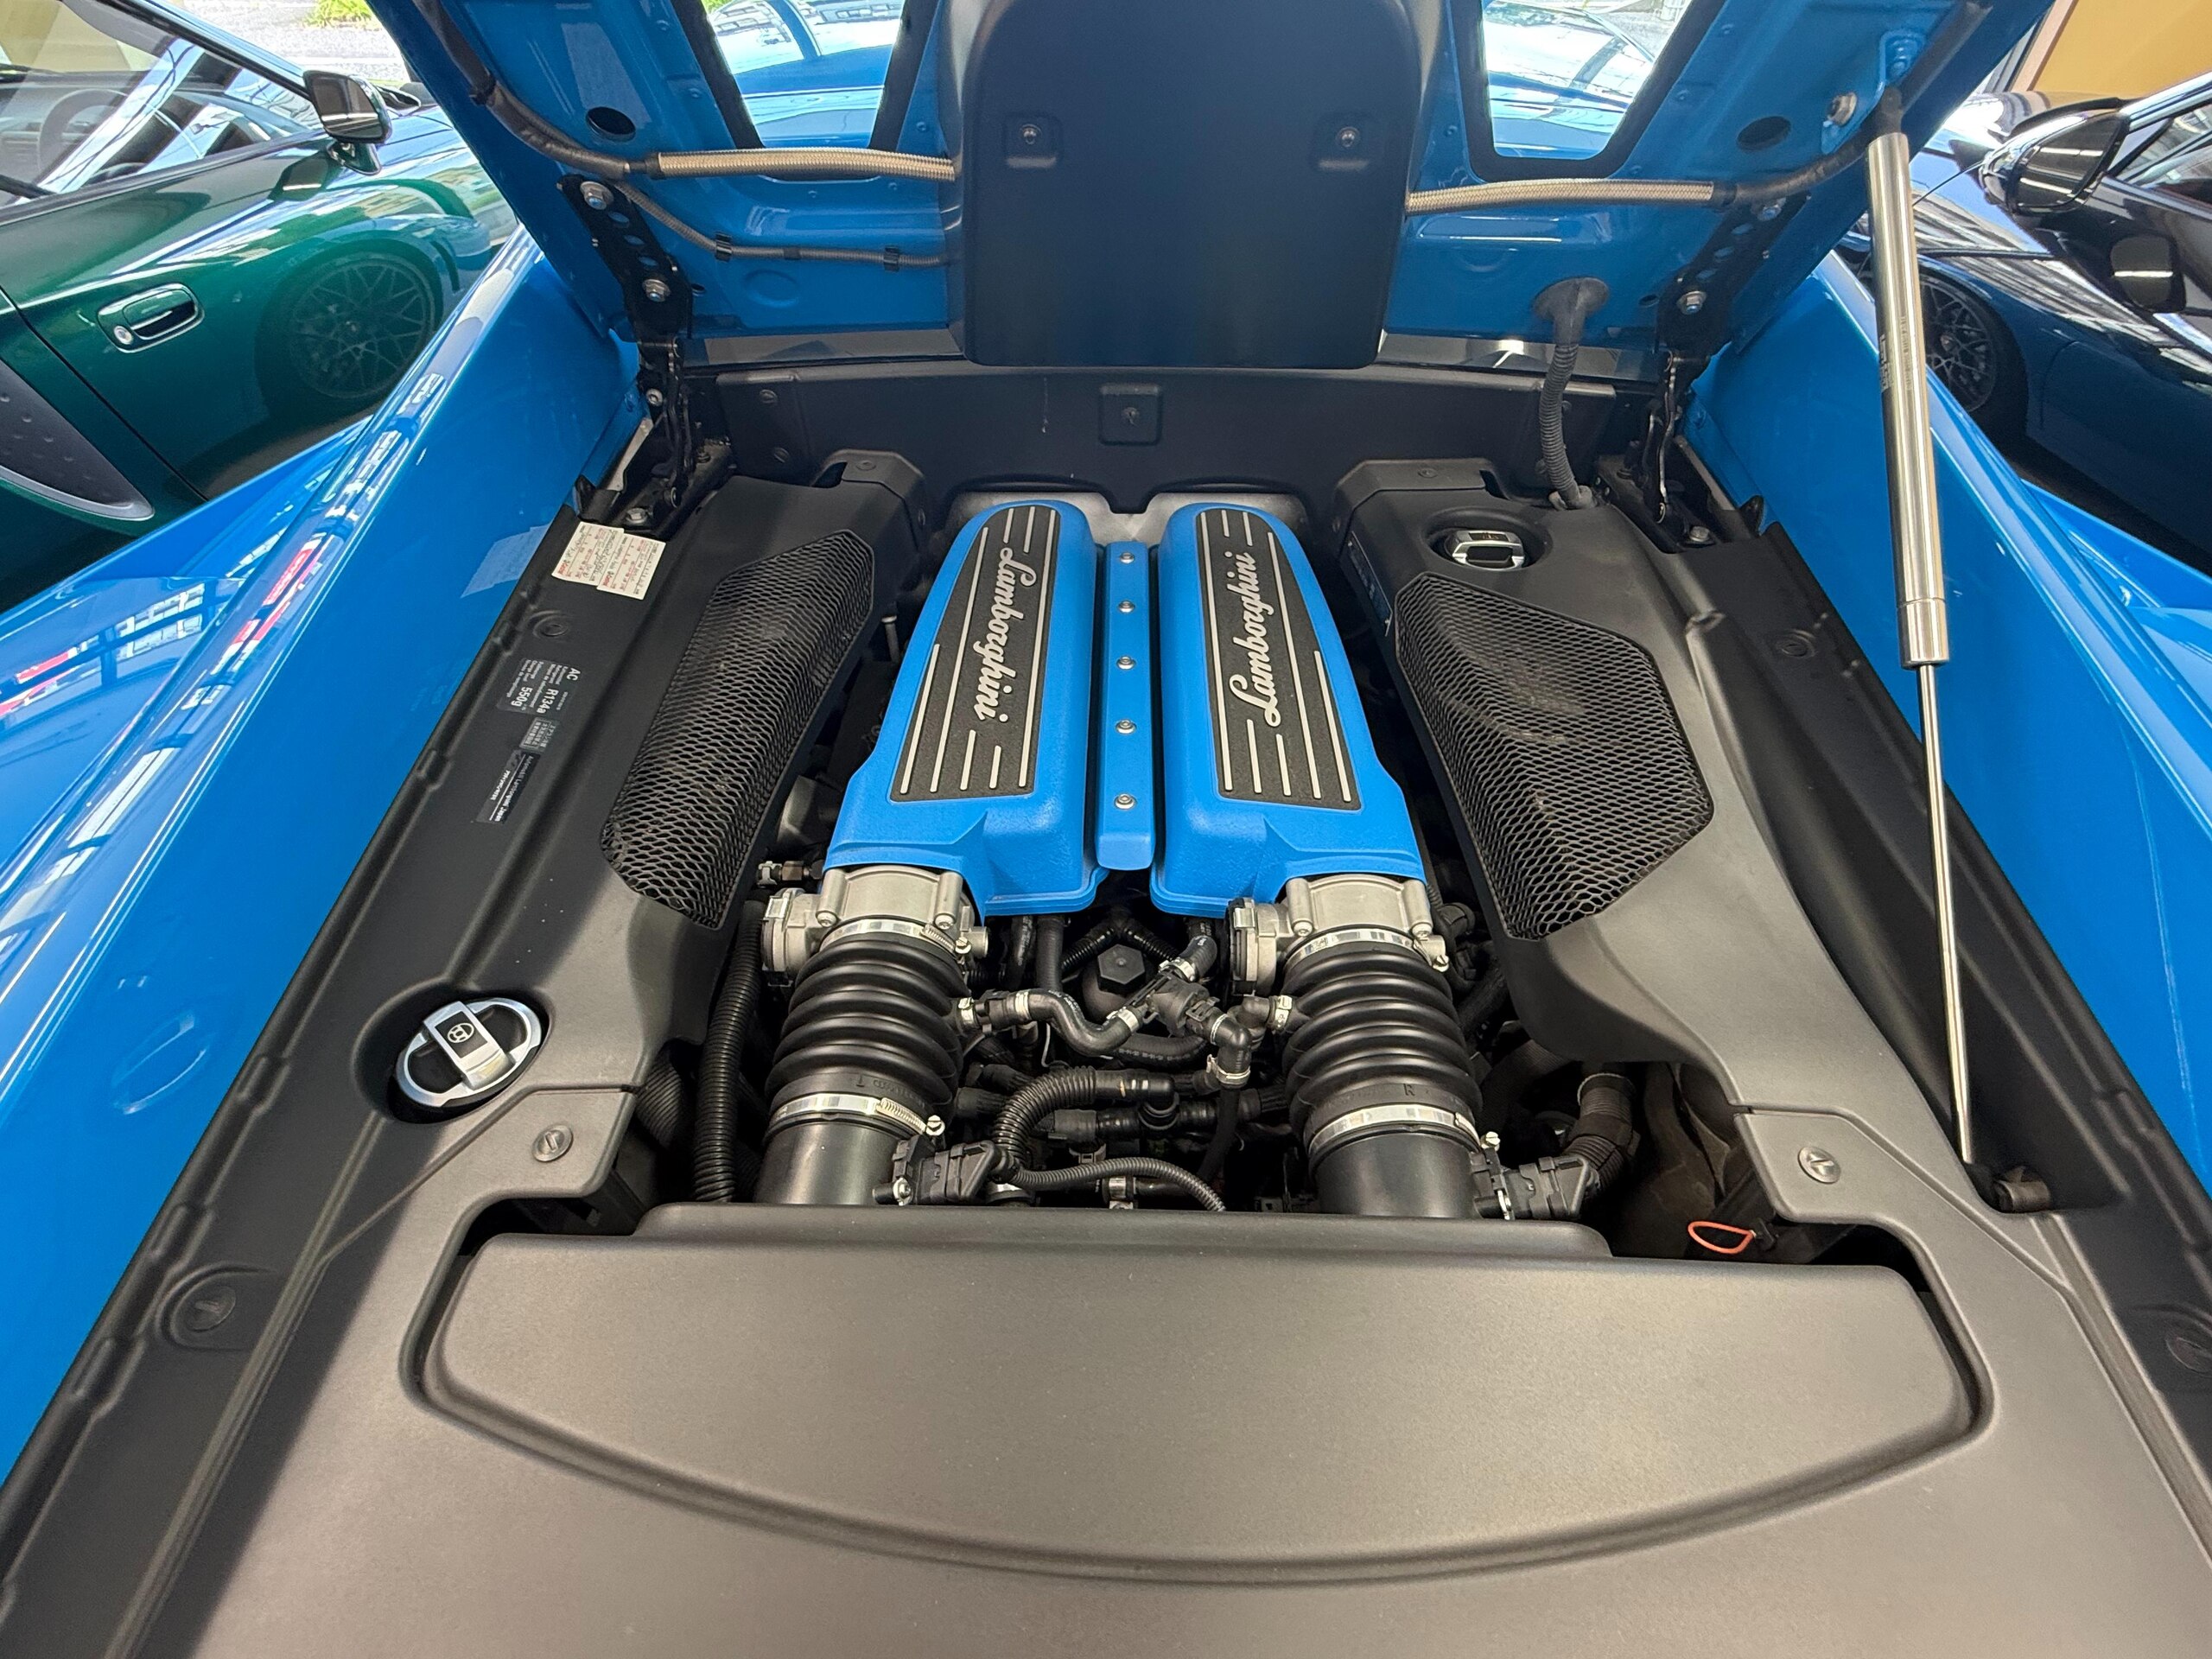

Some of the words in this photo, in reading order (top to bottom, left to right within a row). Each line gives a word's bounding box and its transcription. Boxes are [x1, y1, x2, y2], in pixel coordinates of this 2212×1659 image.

[974, 547, 1037, 722] Lamborghini
[1224, 550, 1281, 728] Lamborghini
[566, 667, 582, 682] AC
[511, 686, 533, 708] 550g
[537, 688, 559, 714] R134a
